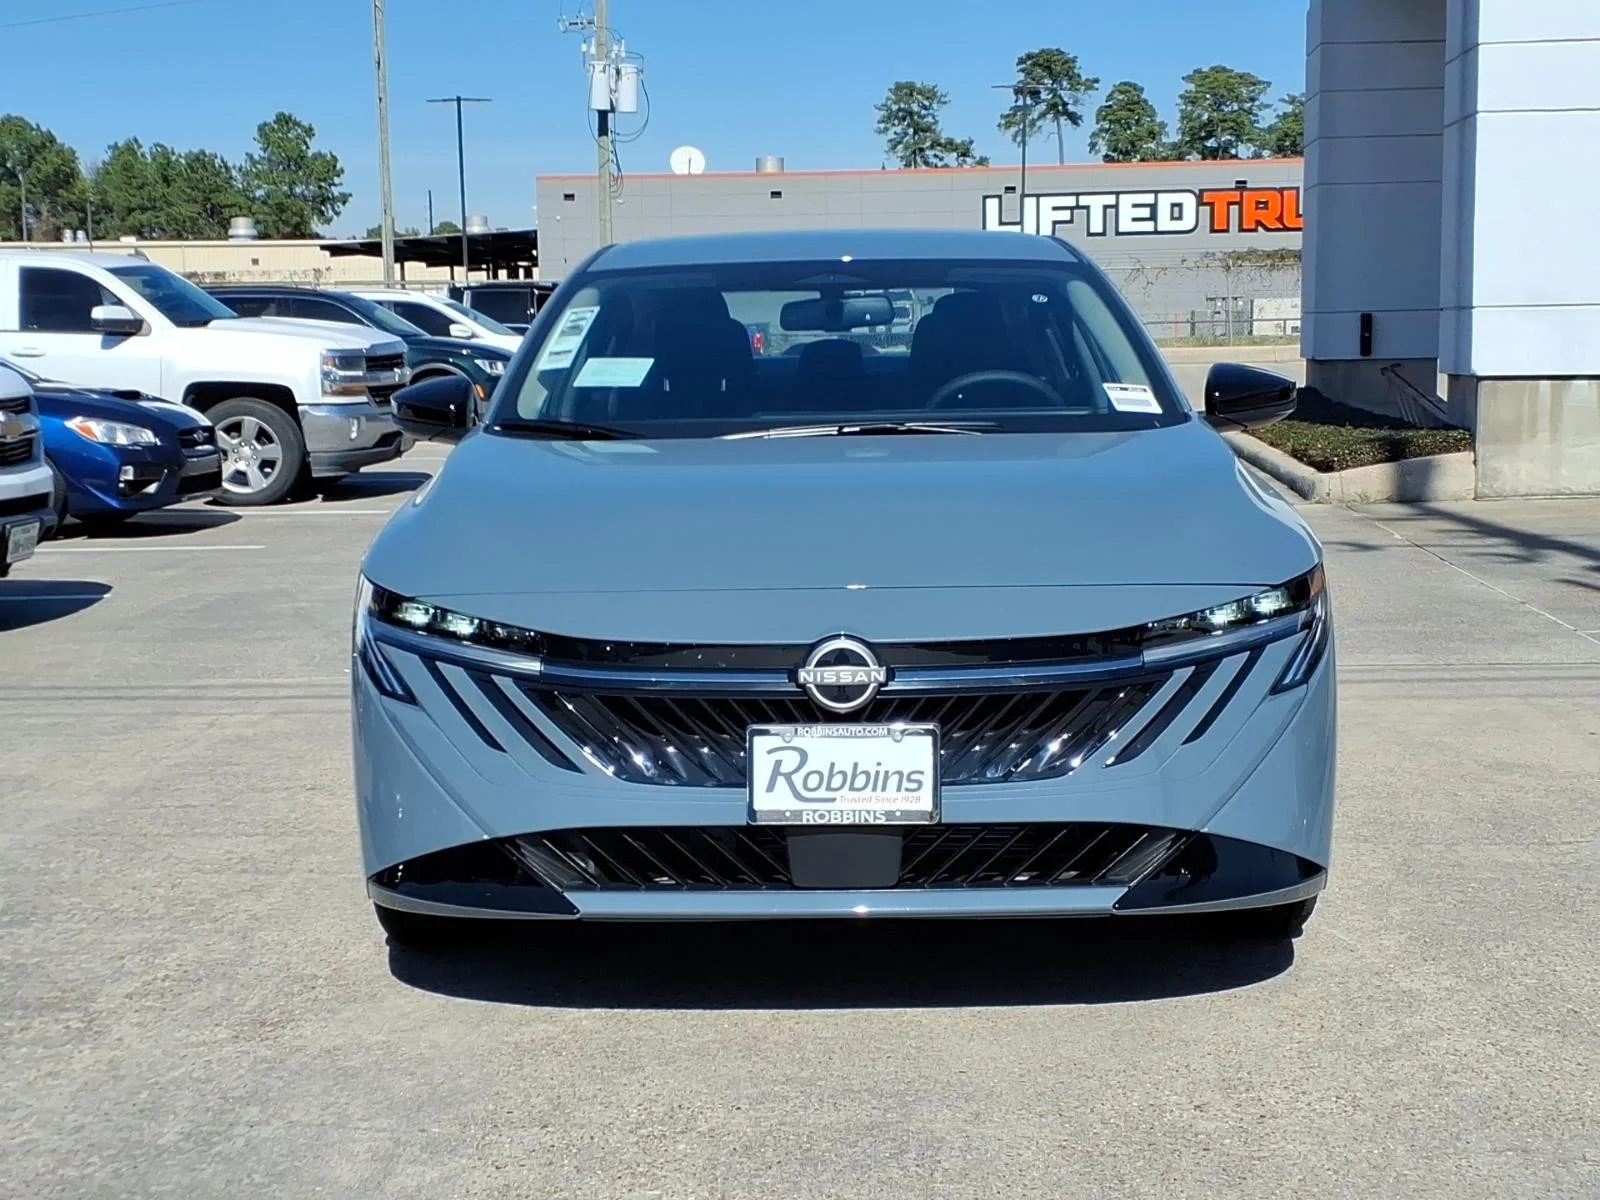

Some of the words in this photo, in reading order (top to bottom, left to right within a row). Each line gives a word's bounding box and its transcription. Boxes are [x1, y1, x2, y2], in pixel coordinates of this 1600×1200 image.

[800, 671, 886, 683] NISSAN
[797, 726, 888, 737] ROBBINSAUTO.COM
[765, 745, 925, 803] Robbins
[840, 795, 872, 804] Trusted
[875, 795, 899, 804] Since
[901, 795, 921, 804] 1928
[802, 809, 886, 824] ROBBINS
